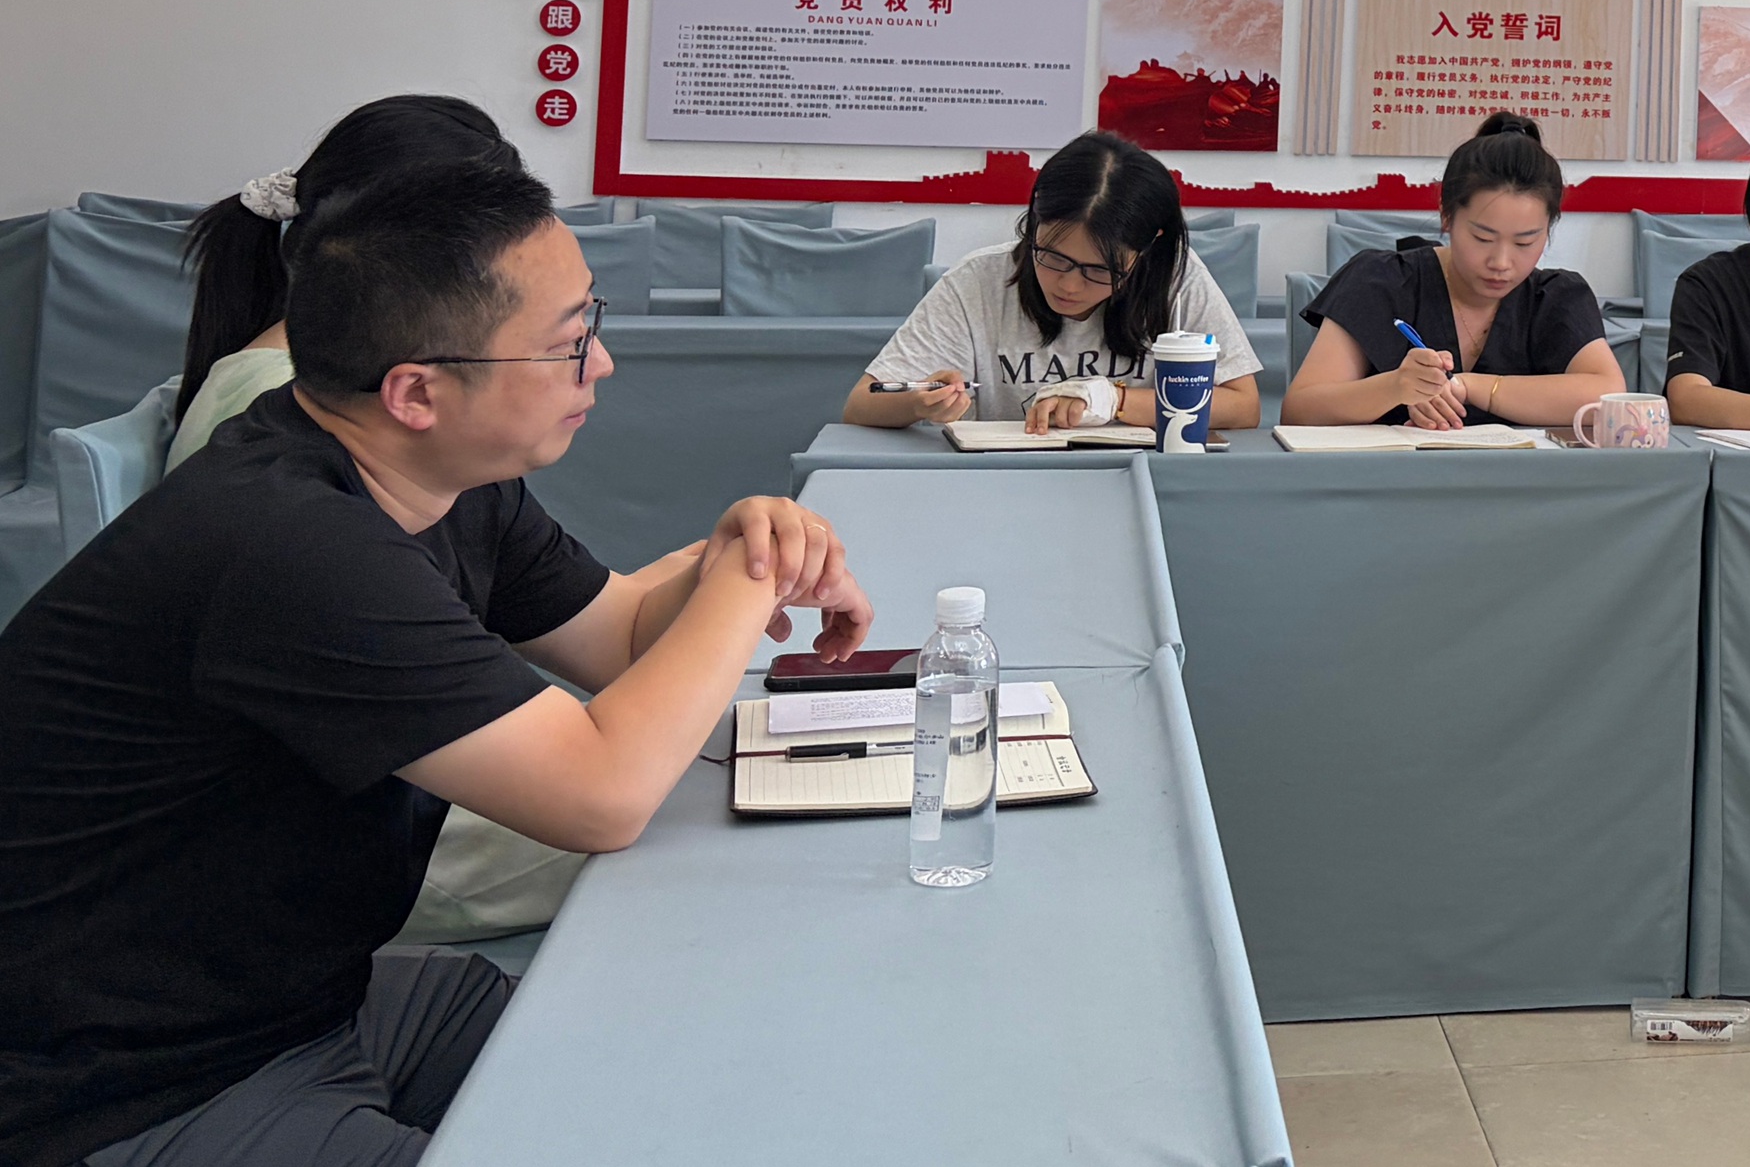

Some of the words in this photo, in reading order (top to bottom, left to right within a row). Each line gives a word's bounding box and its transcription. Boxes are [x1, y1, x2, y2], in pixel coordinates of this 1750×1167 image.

[807, 14, 844, 25] DANG
[847, 16, 884, 26] YUAN
[886, 17, 924, 28] QUAN
[926, 19, 938, 28] LI
[1431, 11, 1562, 42] 入党誓词
[998, 350, 1147, 385] MARDI
